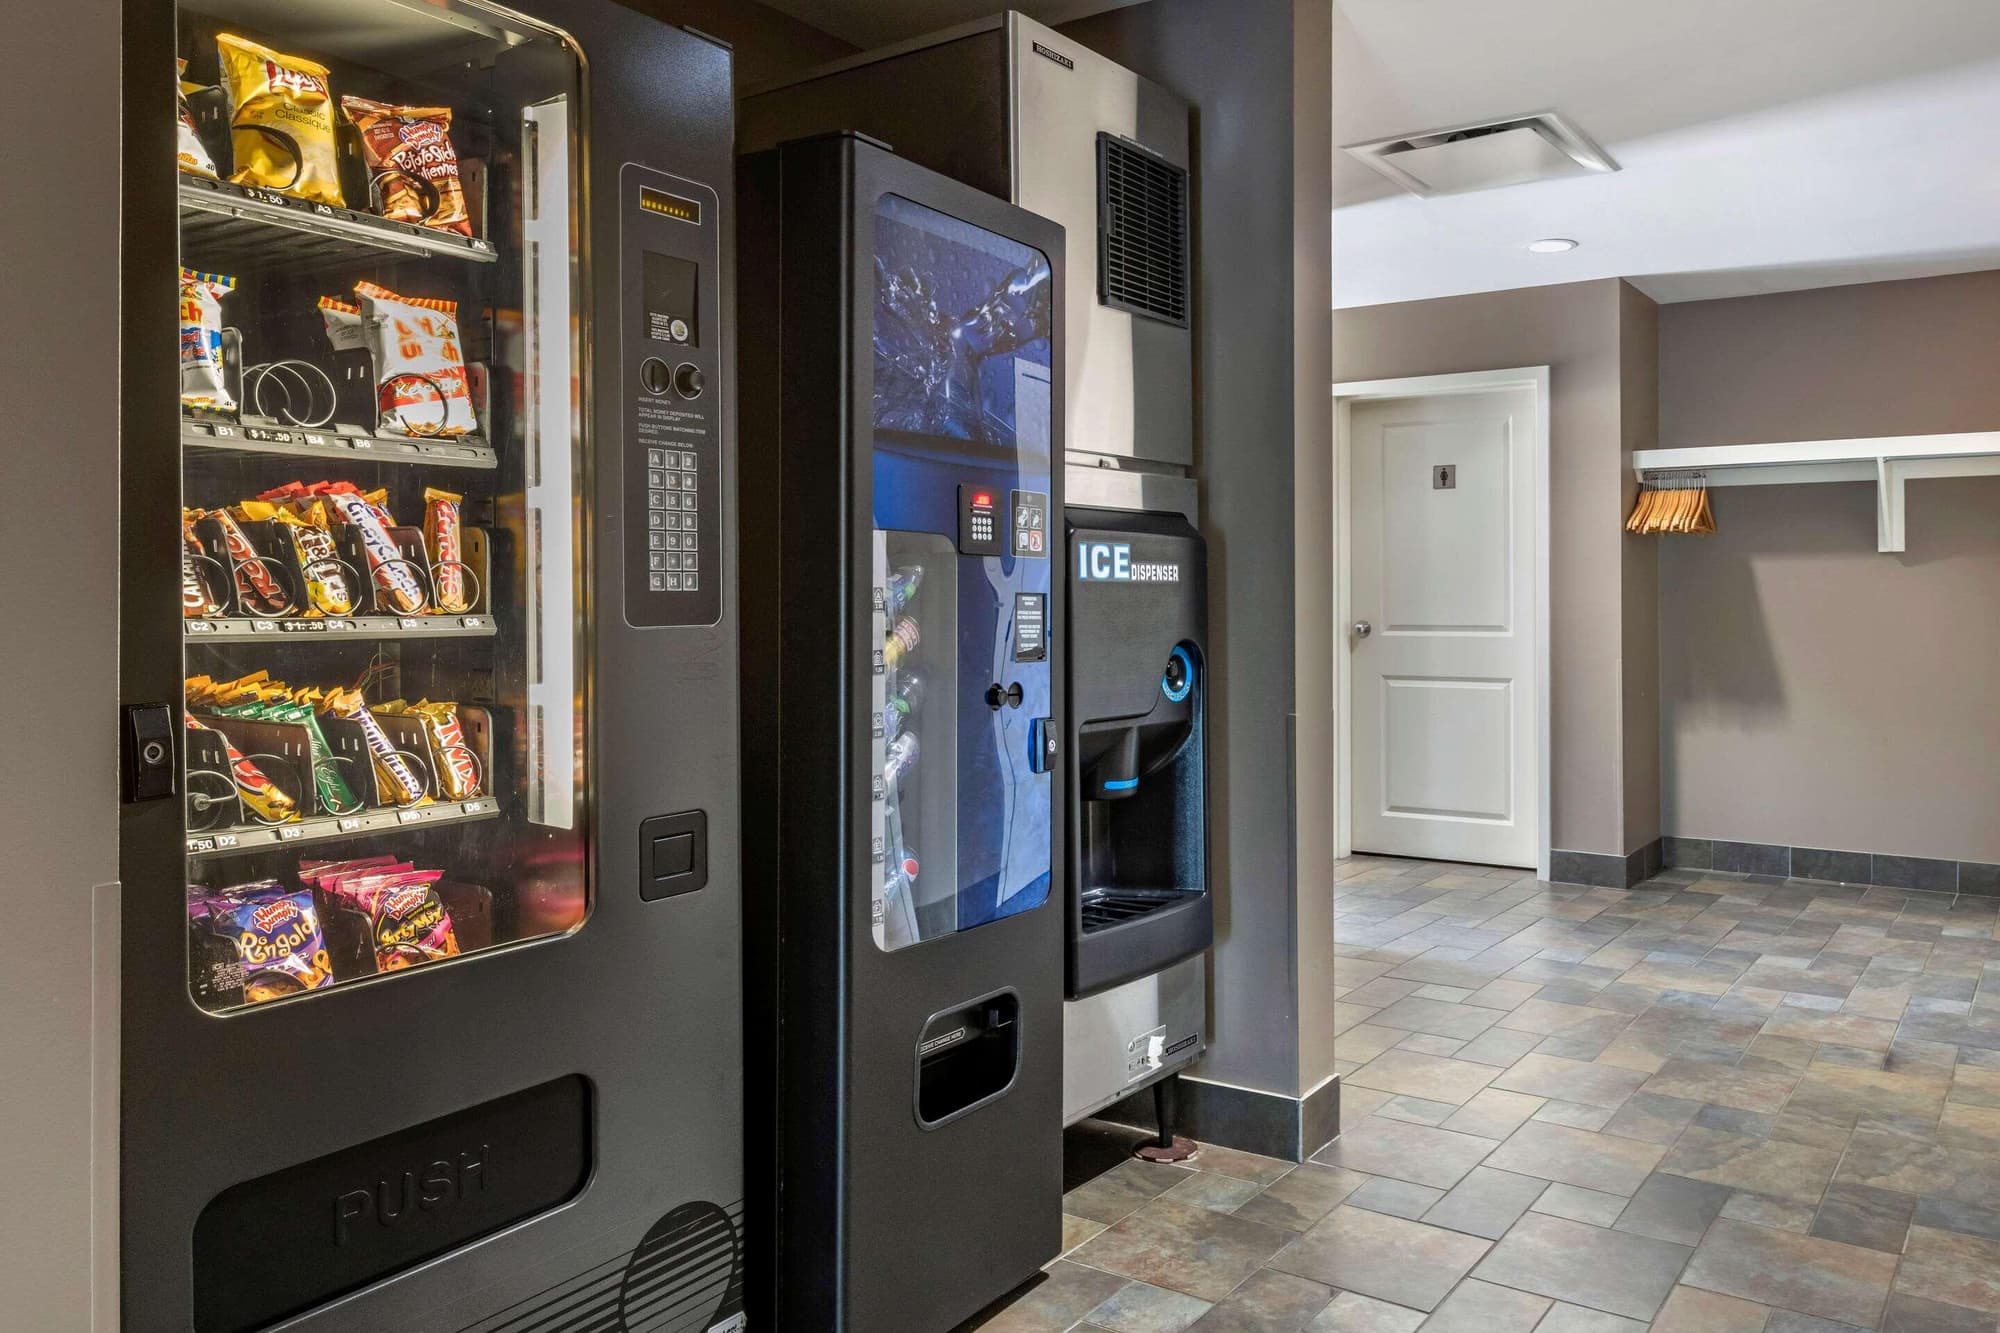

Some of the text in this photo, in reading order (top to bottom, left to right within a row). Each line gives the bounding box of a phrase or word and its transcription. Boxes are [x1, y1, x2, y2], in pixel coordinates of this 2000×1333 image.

[283, 102, 326, 121] Classic
[275, 108, 331, 133] Classique
[392, 148, 433, 170] Potato
[317, 205, 331, 215] A3
[218, 427, 234, 436] B1
[1079, 543, 1130, 579] ICE
[1131, 564, 1179, 581] DISPENSER
[191, 622, 209, 631] C2
[257, 621, 273, 630] C3
[328, 620, 344, 630] C4
[402, 619, 417, 628] C5
[438, 713, 477, 796] TWIX
[342, 820, 359, 830] D4
[284, 829, 300, 838] D3
[219, 836, 237, 846] D2
[254, 900, 294, 921] Humpty
[256, 907, 298, 933] Dumpty
[335, 1144, 489, 1246] PUSH
